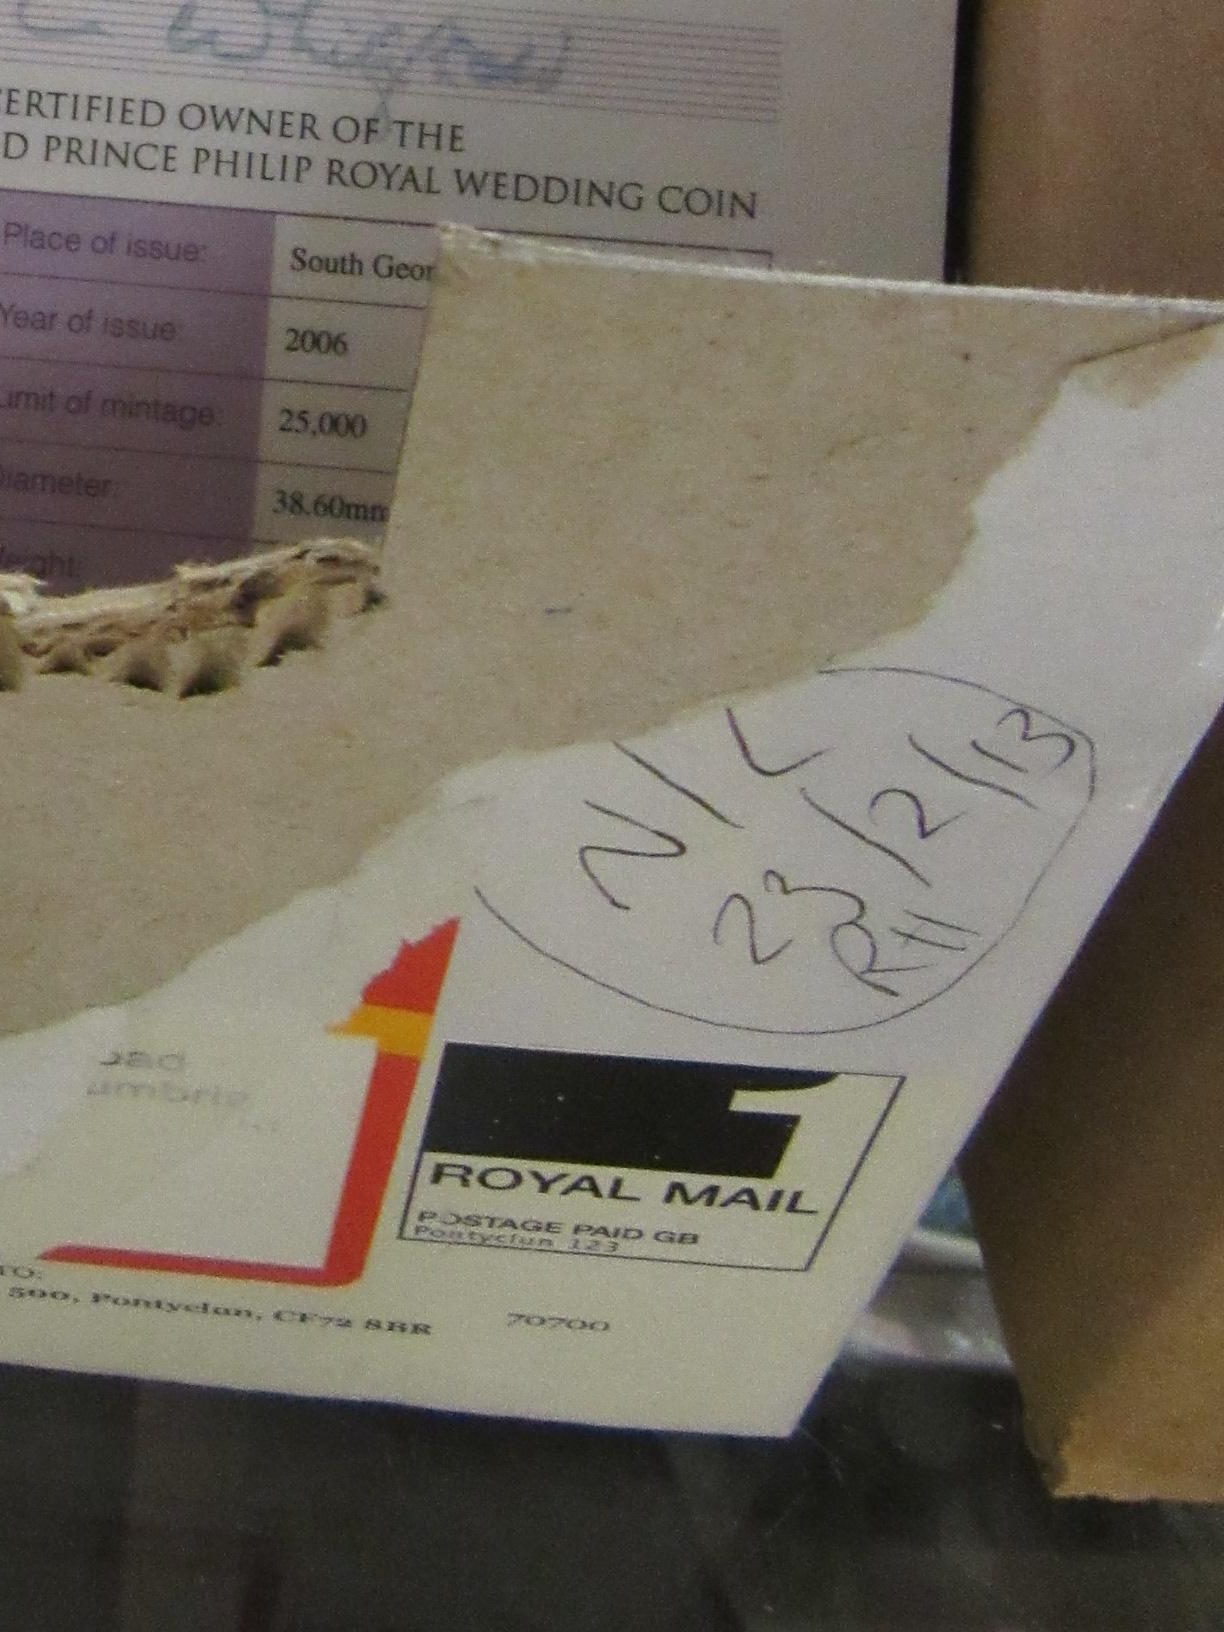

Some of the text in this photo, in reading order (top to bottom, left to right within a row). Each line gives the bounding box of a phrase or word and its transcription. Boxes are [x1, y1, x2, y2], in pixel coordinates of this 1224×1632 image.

[179, 103, 321, 142] OWNER
[332, 116, 379, 144] OF
[393, 120, 466, 153] THE
[43, 136, 178, 173] PRINCE
[193, 149, 313, 184] PHILIP
[326, 159, 442, 195] ROYAL
[454, 170, 645, 211] WEDDING
[658, 185, 757, 220] COIN
[3, 222, 79, 253] Place
[91, 229, 117, 254] of
[290, 248, 434, 282] South Geor
[68, 309, 93, 333] of
[285, 328, 348, 356] 2006
[64, 390, 93, 415] of
[279, 408, 367, 439] 25,000
[430, 1162, 818, 1215] ROYAL MAIL
[414, 1225, 620, 1253] Pontyclun 123
[418, 1210, 701, 1246] POSTAGE PAID GB
[8, 1287, 80, 1305] 500,
